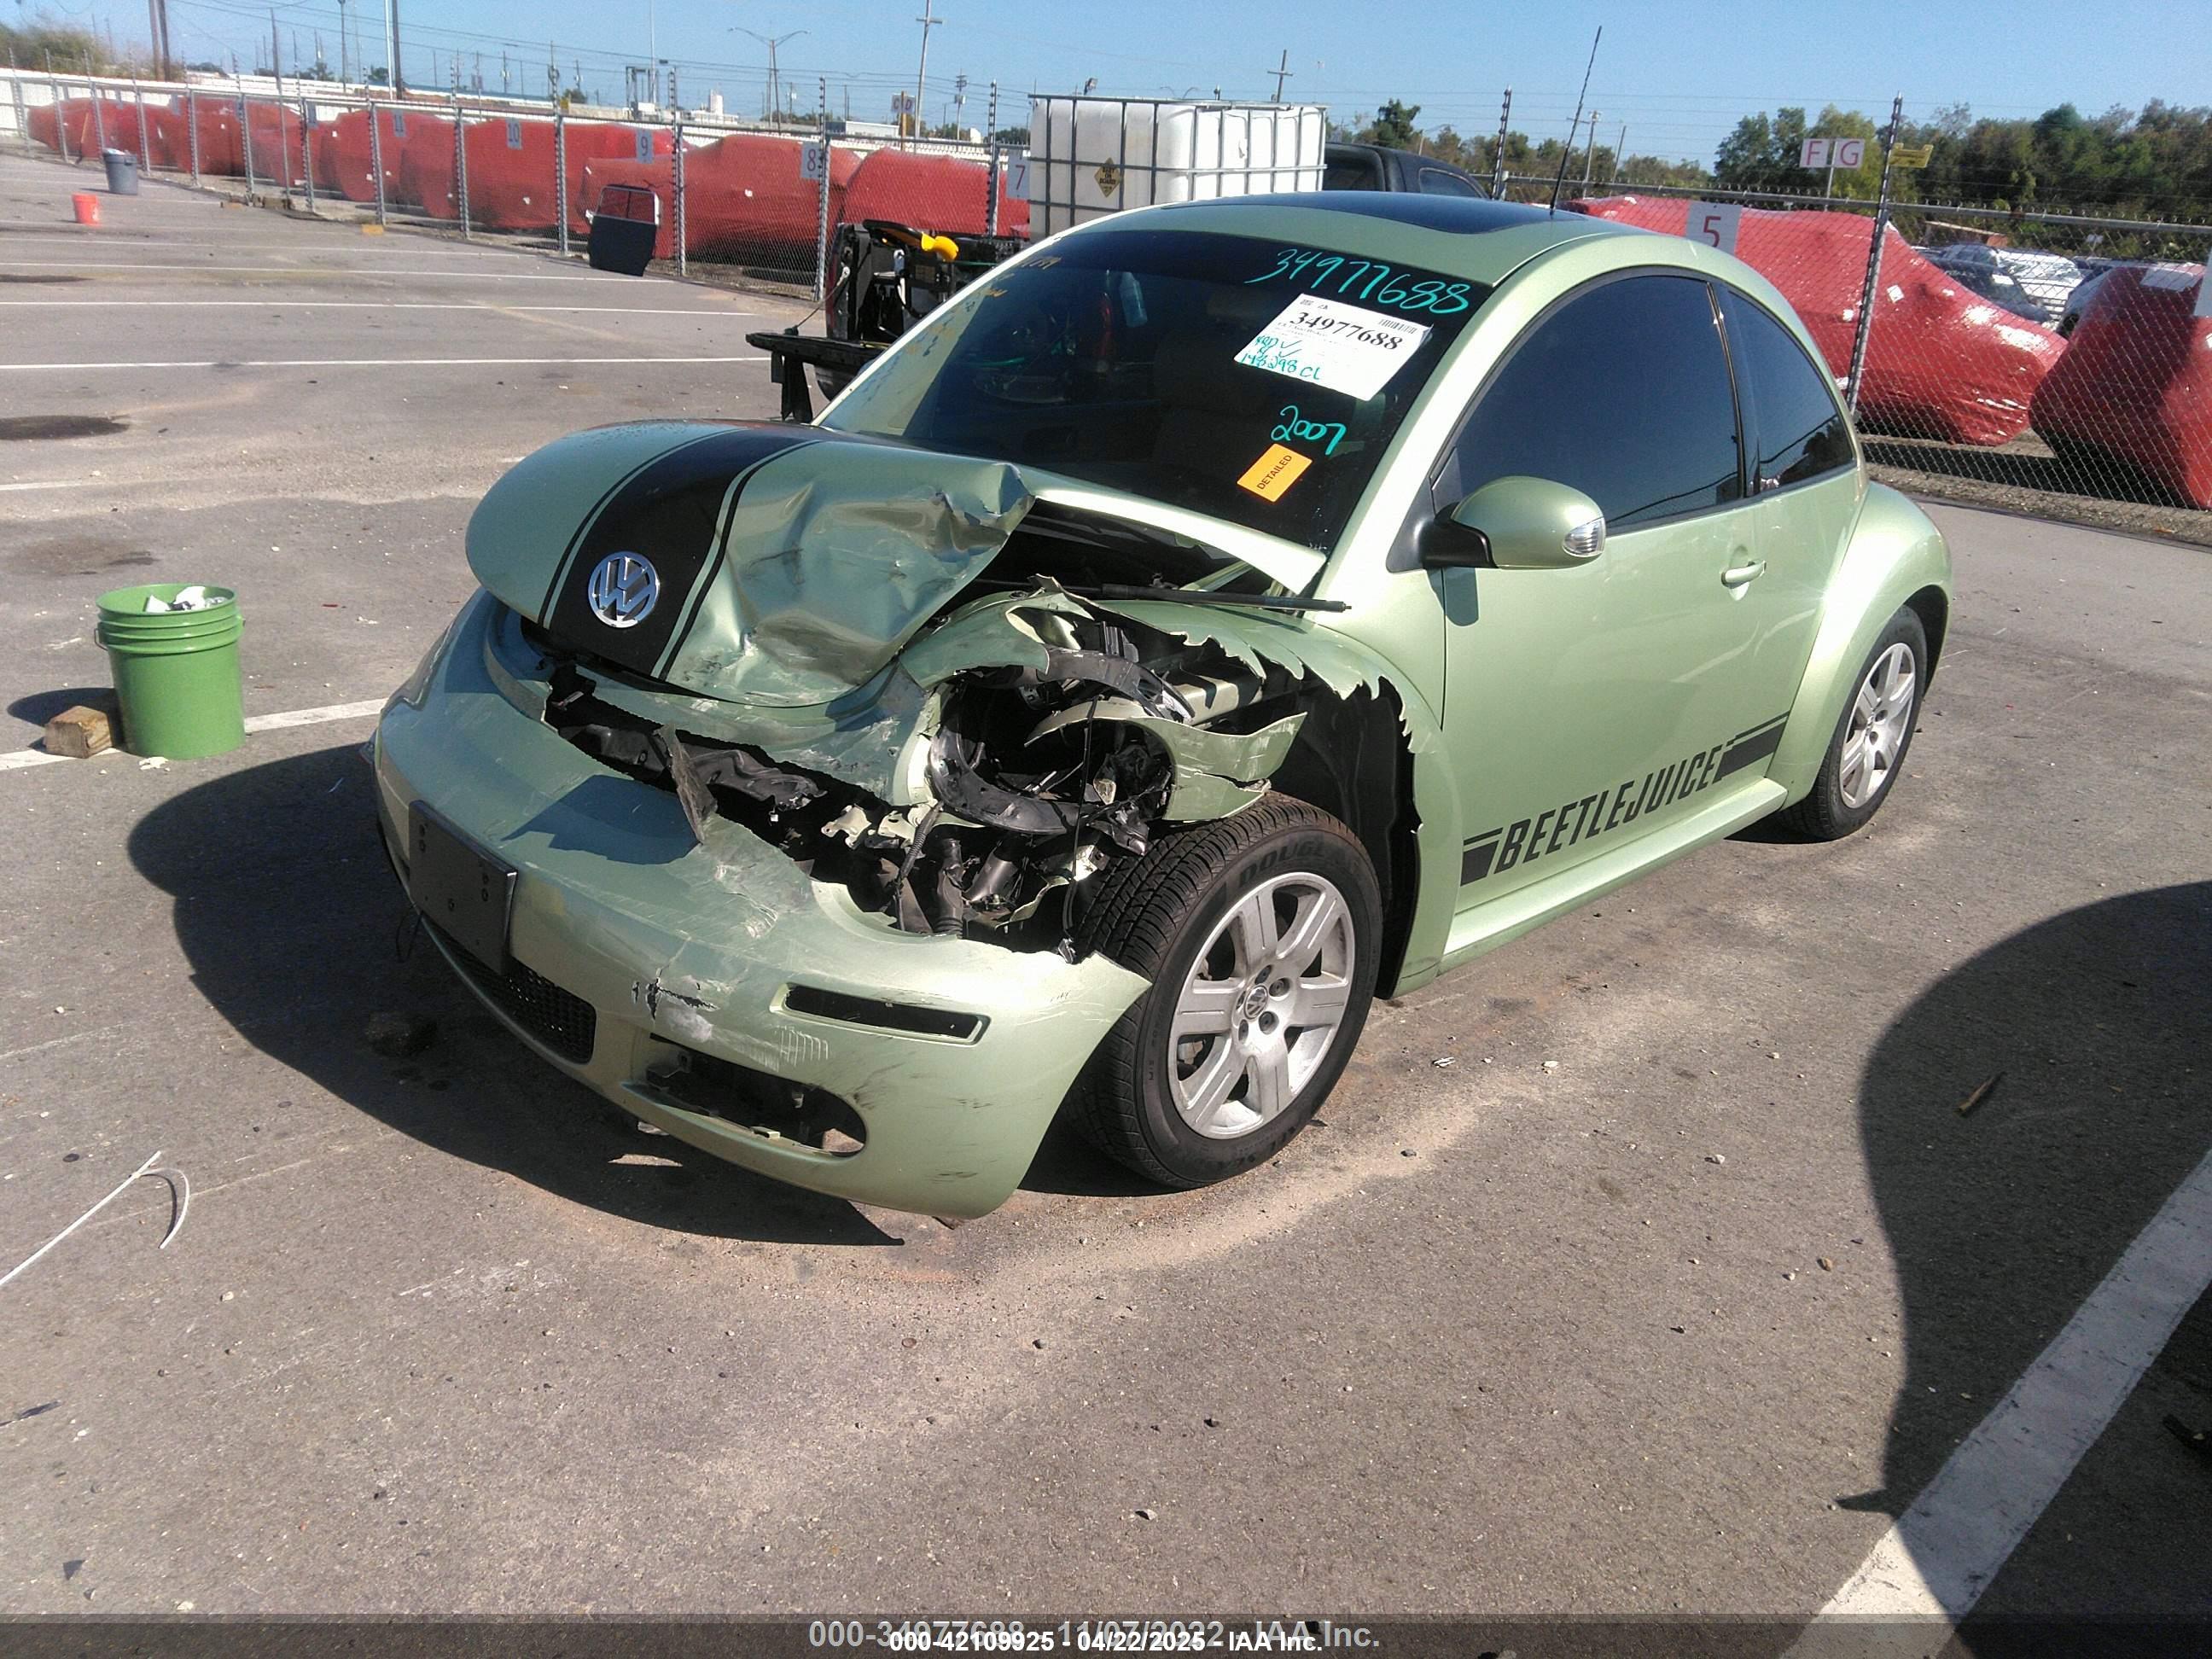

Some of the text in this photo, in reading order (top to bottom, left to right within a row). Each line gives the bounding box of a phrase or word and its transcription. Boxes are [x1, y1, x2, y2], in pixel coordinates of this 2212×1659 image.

[640, 136, 649, 156] 9
[806, 148, 817, 172] 8
[1805, 140, 1823, 166] F
[1840, 140, 1860, 166] G
[1015, 164, 1026, 190] 7
[1703, 215, 1721, 247] 5
[1243, 247, 1471, 314] 34977688
[1289, 311, 1404, 350] 34977688
[1271, 405, 1347, 456] 2007
[1256, 455, 1293, 490] DETAILED
[1493, 743, 1723, 875] BEETLEJUICE
